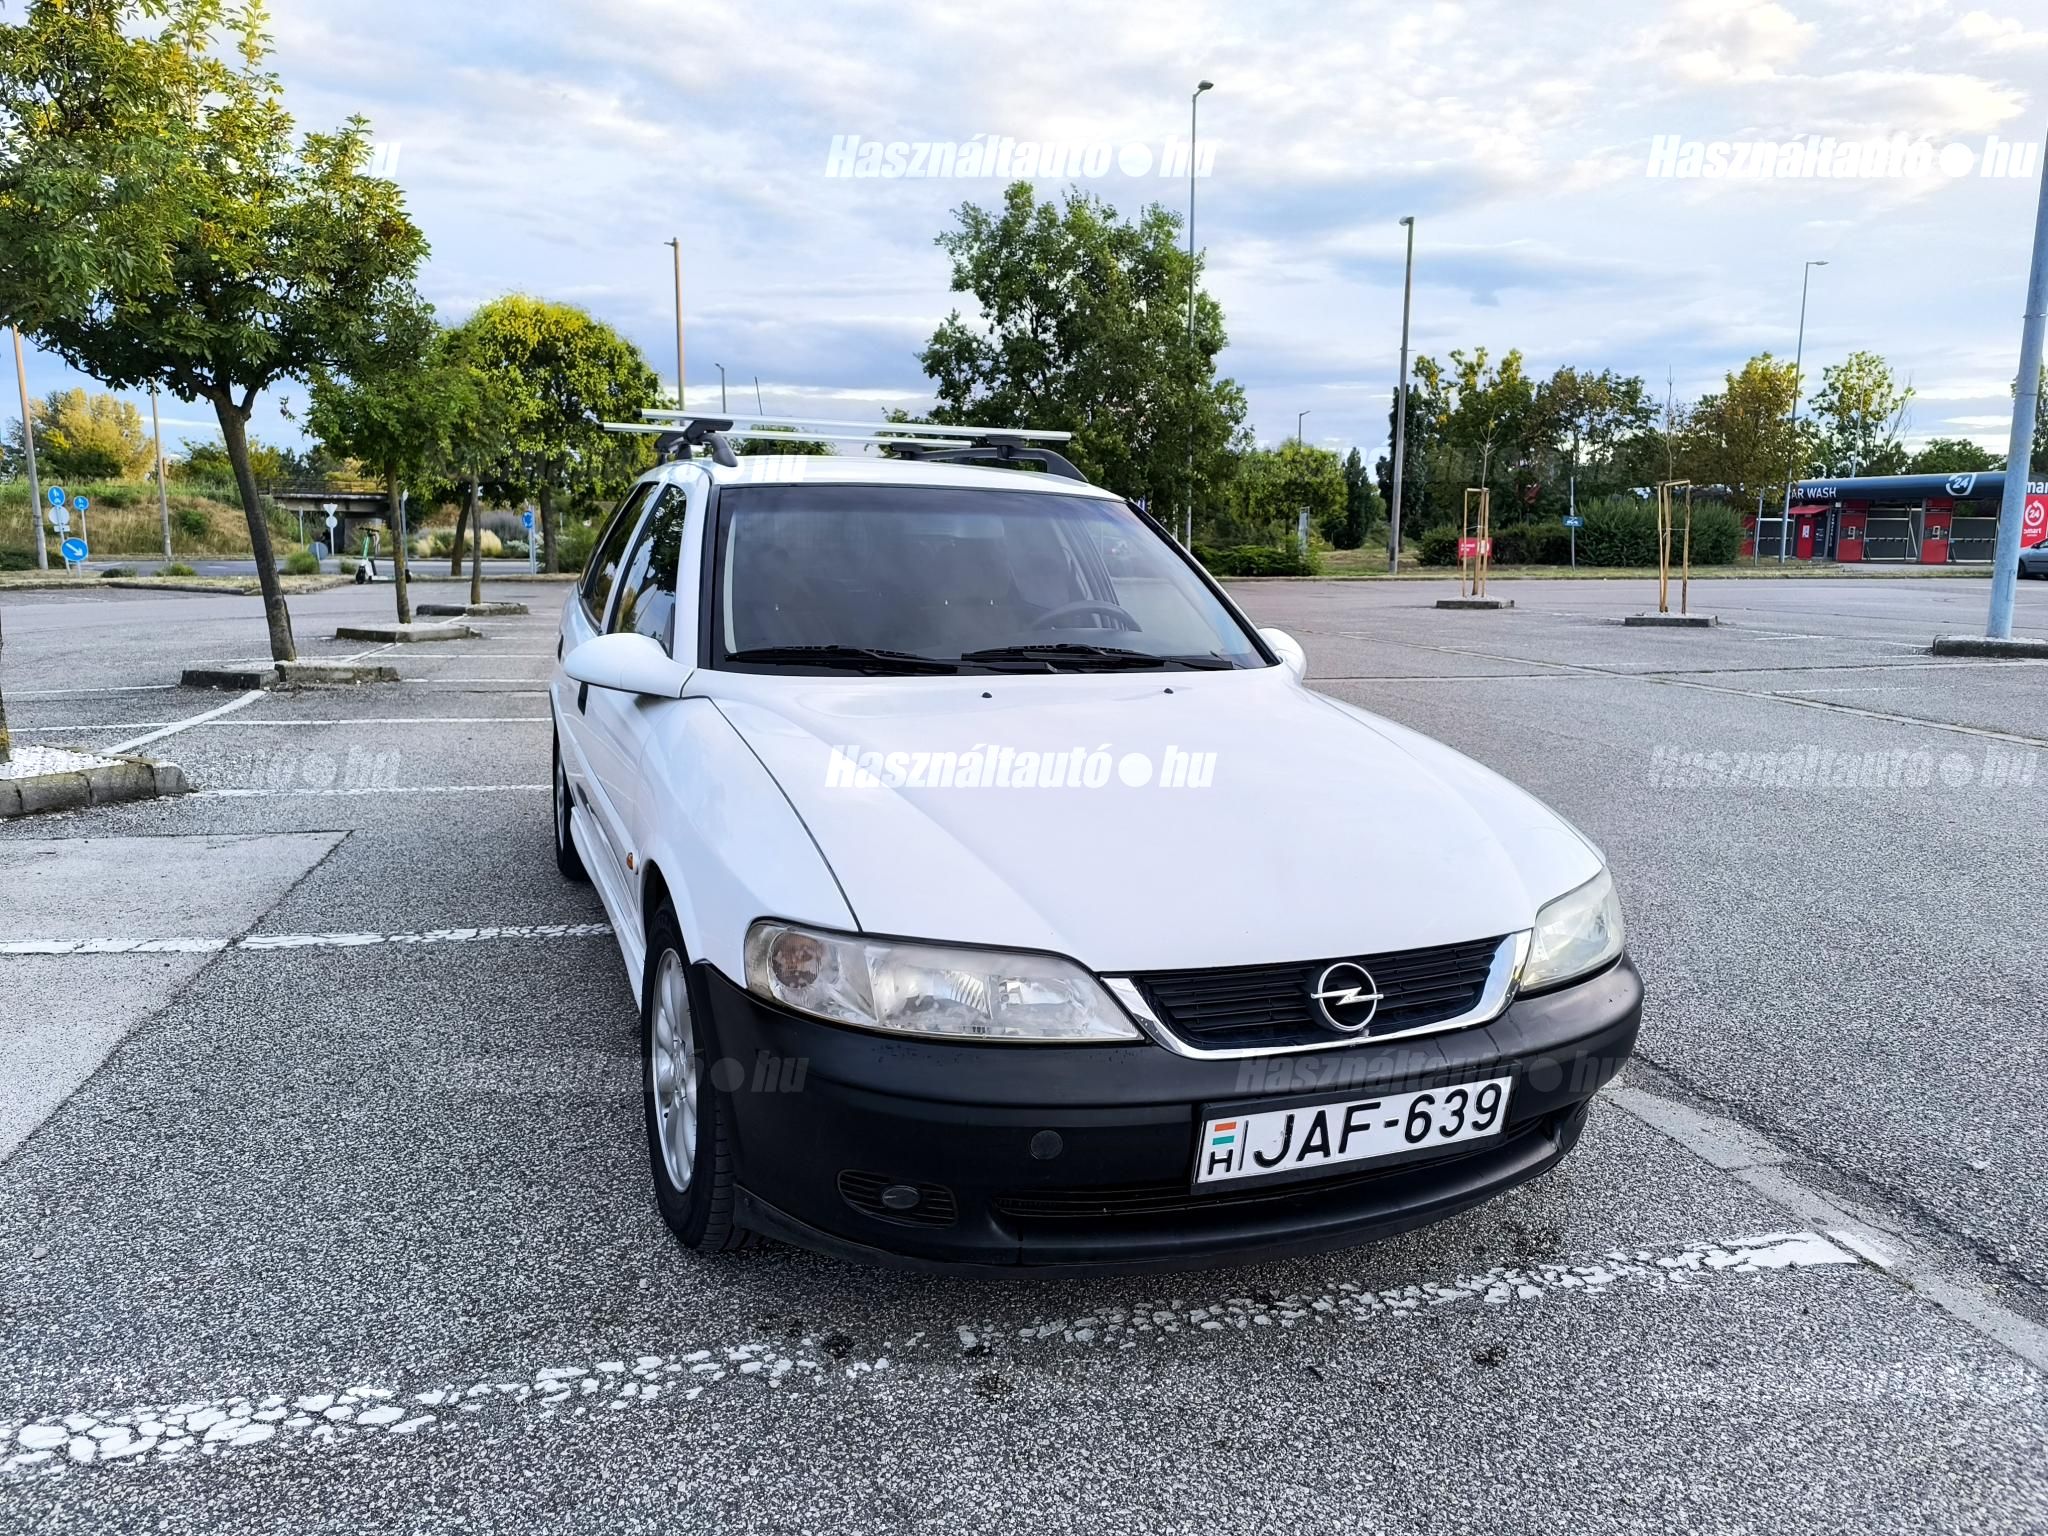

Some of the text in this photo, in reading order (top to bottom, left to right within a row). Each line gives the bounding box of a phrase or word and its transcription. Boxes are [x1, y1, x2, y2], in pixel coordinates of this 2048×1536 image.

[1952, 477, 1970, 489] 24
[1791, 487, 1837, 499] AR WASH
[2028, 508, 2041, 519] 24
[1253, 1082, 1502, 1168] JAF-639
